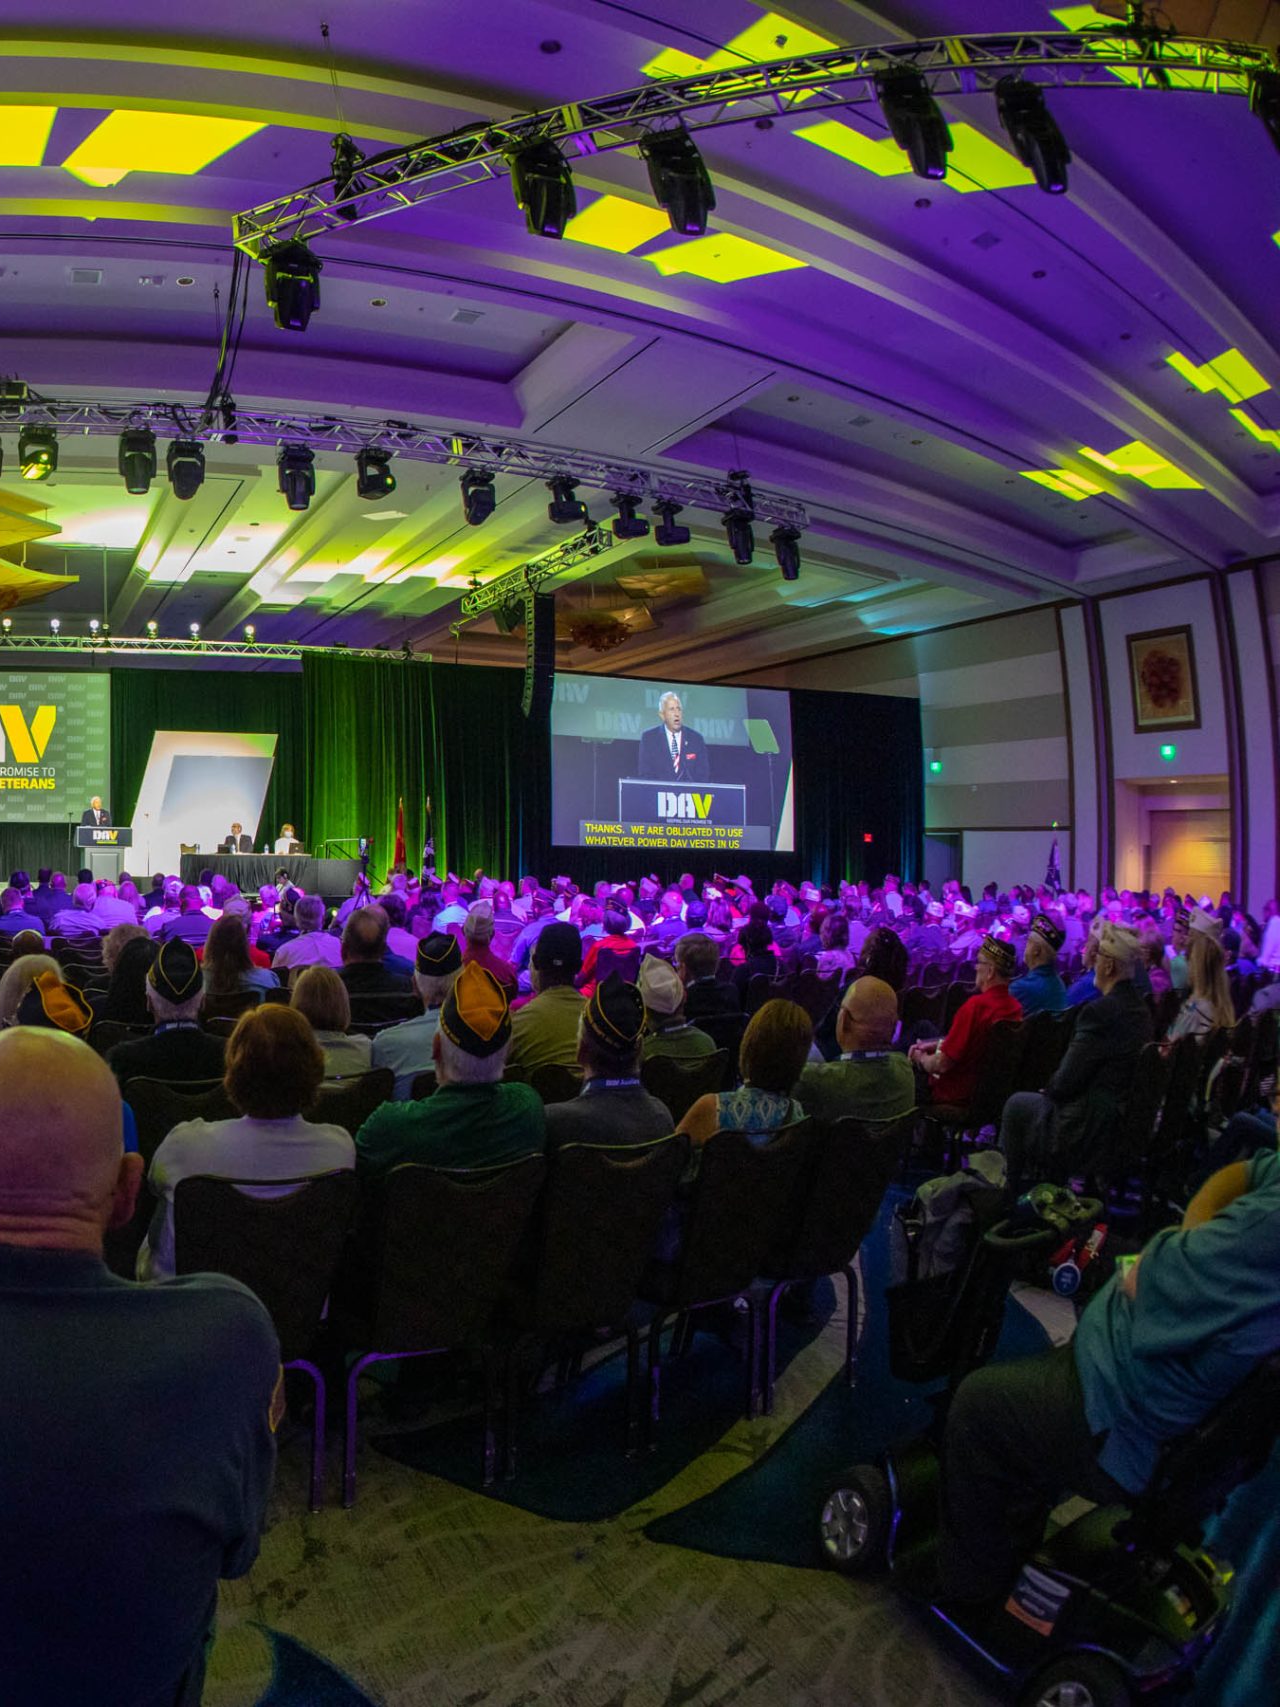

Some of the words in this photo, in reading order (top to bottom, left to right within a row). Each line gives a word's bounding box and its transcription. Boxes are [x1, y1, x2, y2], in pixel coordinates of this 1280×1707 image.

[42, 767, 56, 777] TO
[657, 791, 712, 819] DAV
[92, 830, 118, 840] DAV
[585, 824, 624, 834] THANKS.
[631, 826, 644, 834] WE
[646, 826, 663, 835] ARE
[666, 827, 712, 836] OBLIGATED
[714, 828, 726, 837] TO
[727, 828, 743, 838] USE
[586, 836, 635, 846] WHATEVER
[637, 838, 668, 847] POWER
[670, 839, 688, 848] DAV
[690, 840, 715, 848] VESTS
[718, 840, 726, 848] IN
